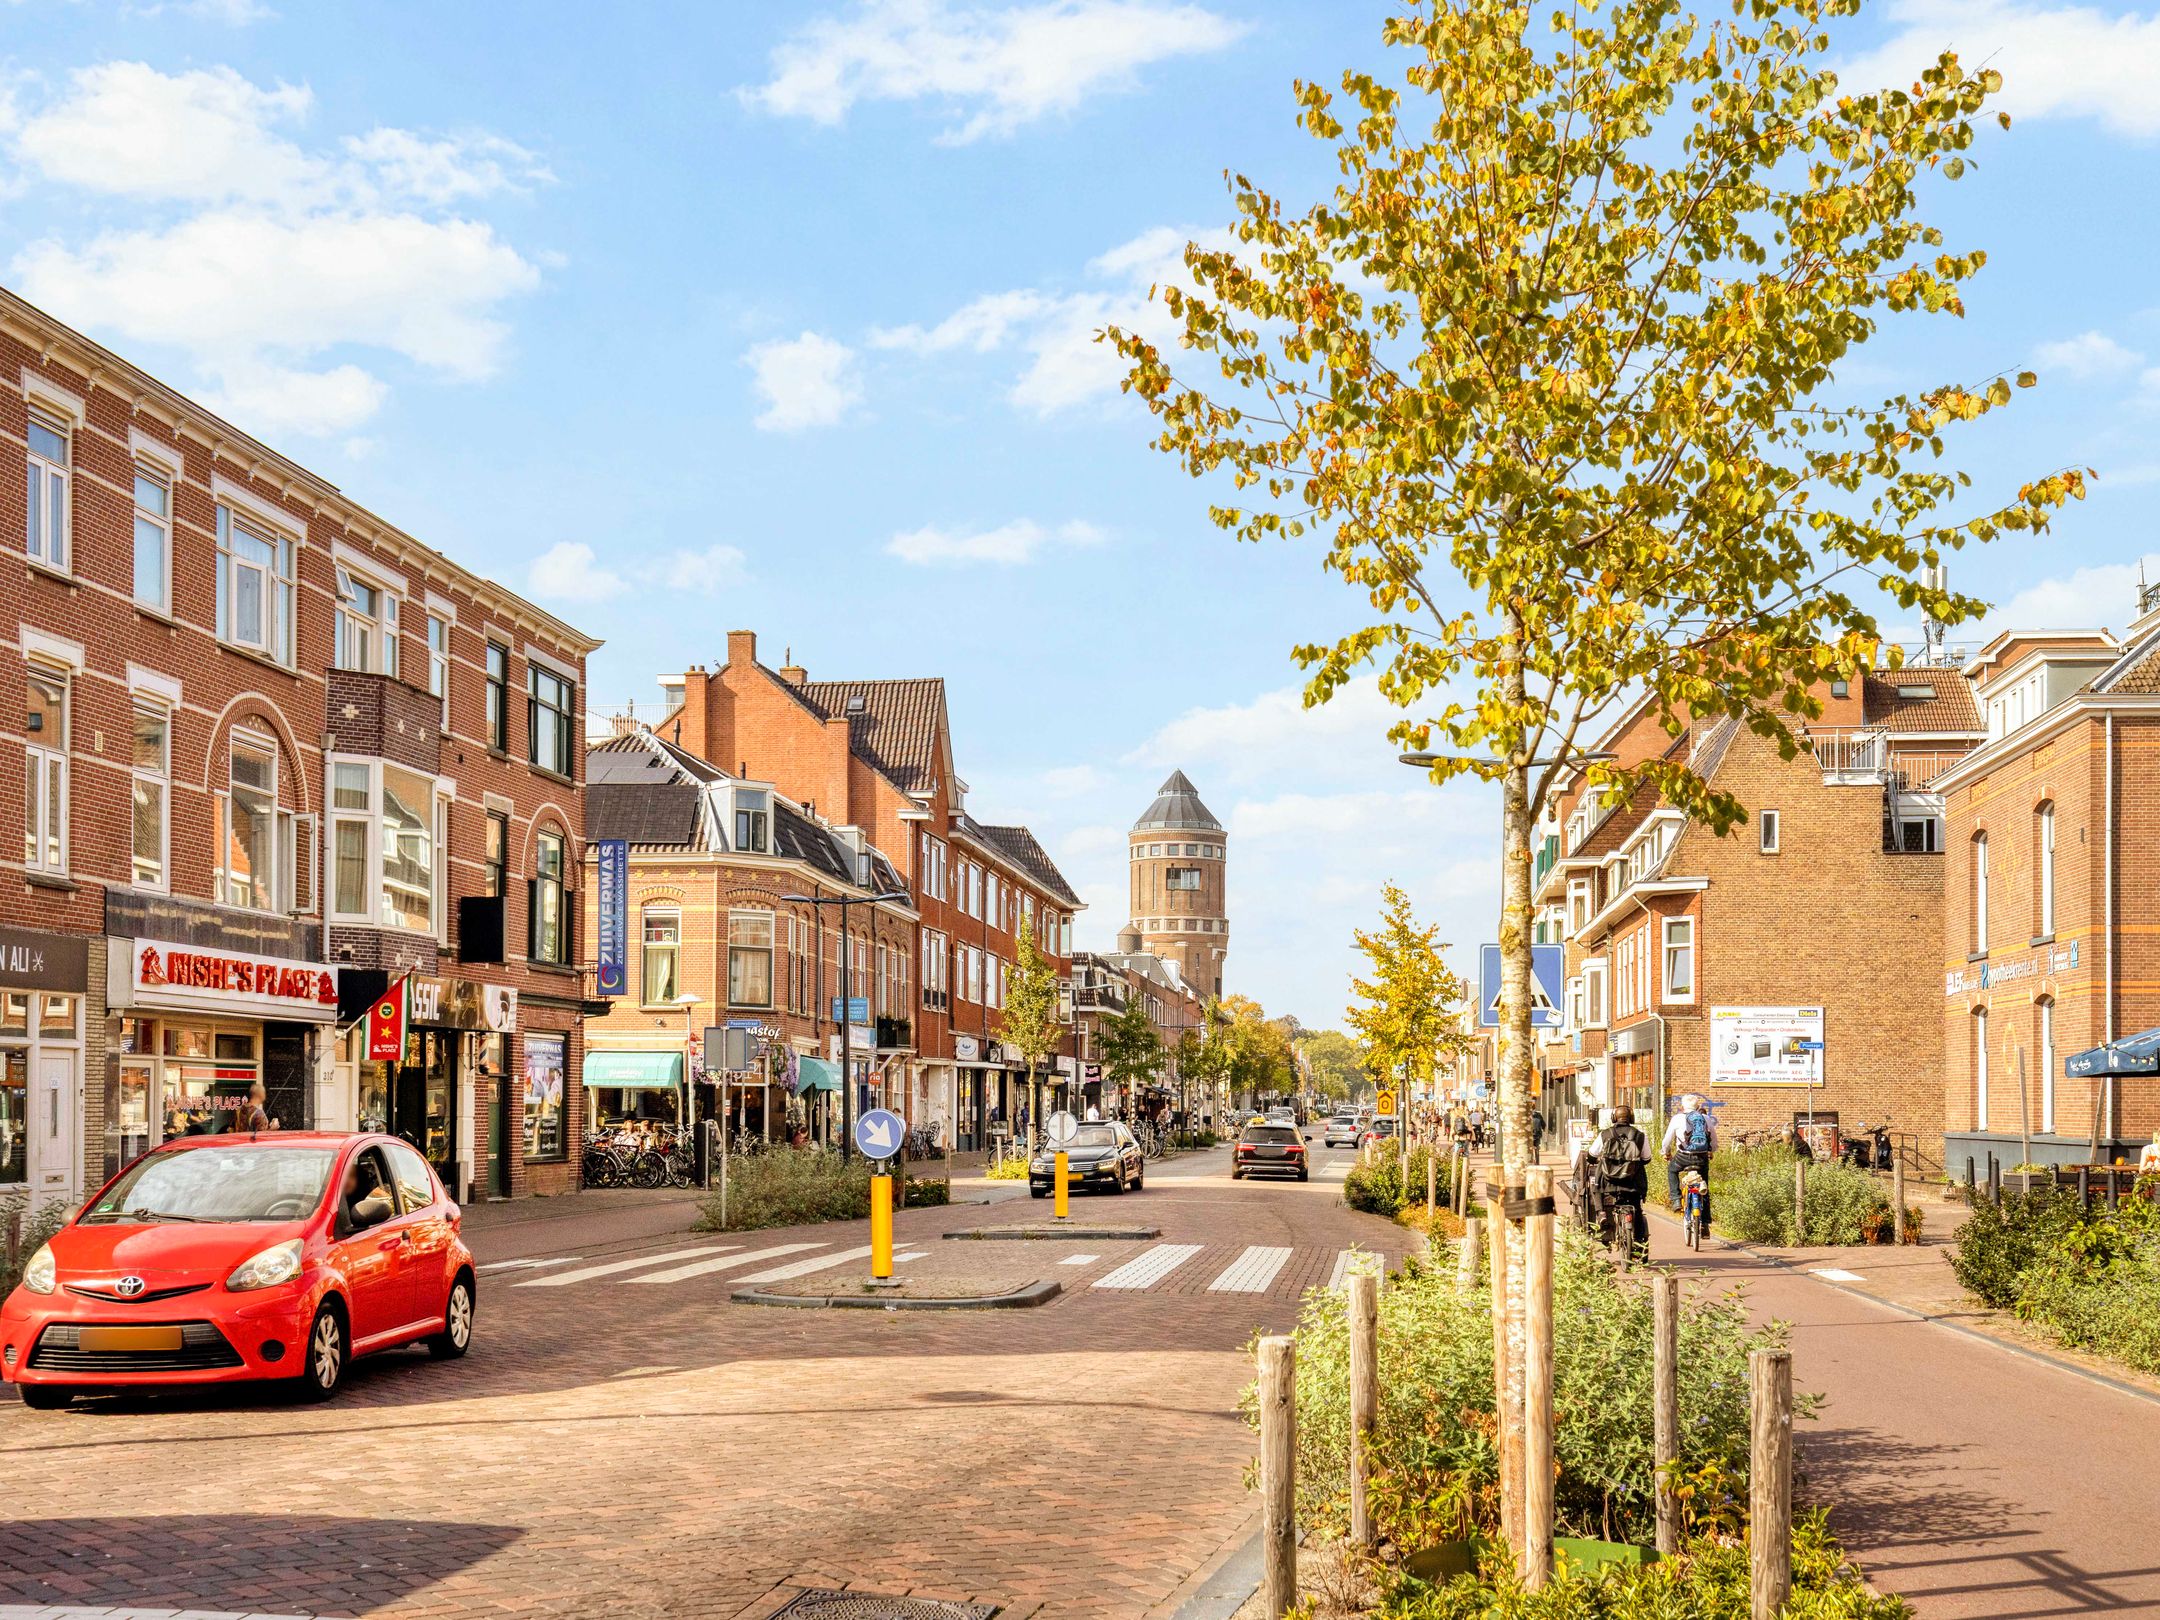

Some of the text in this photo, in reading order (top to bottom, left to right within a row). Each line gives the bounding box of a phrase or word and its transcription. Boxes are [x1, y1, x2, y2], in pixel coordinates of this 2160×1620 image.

[601, 844, 615, 965] ZUIVERWAS
[10, 945, 30, 973] ALI
[167, 951, 319, 1000] NISHE'S PLACE
[869, 1073, 881, 1082] ria
[213, 1095, 241, 1111] PLACE
